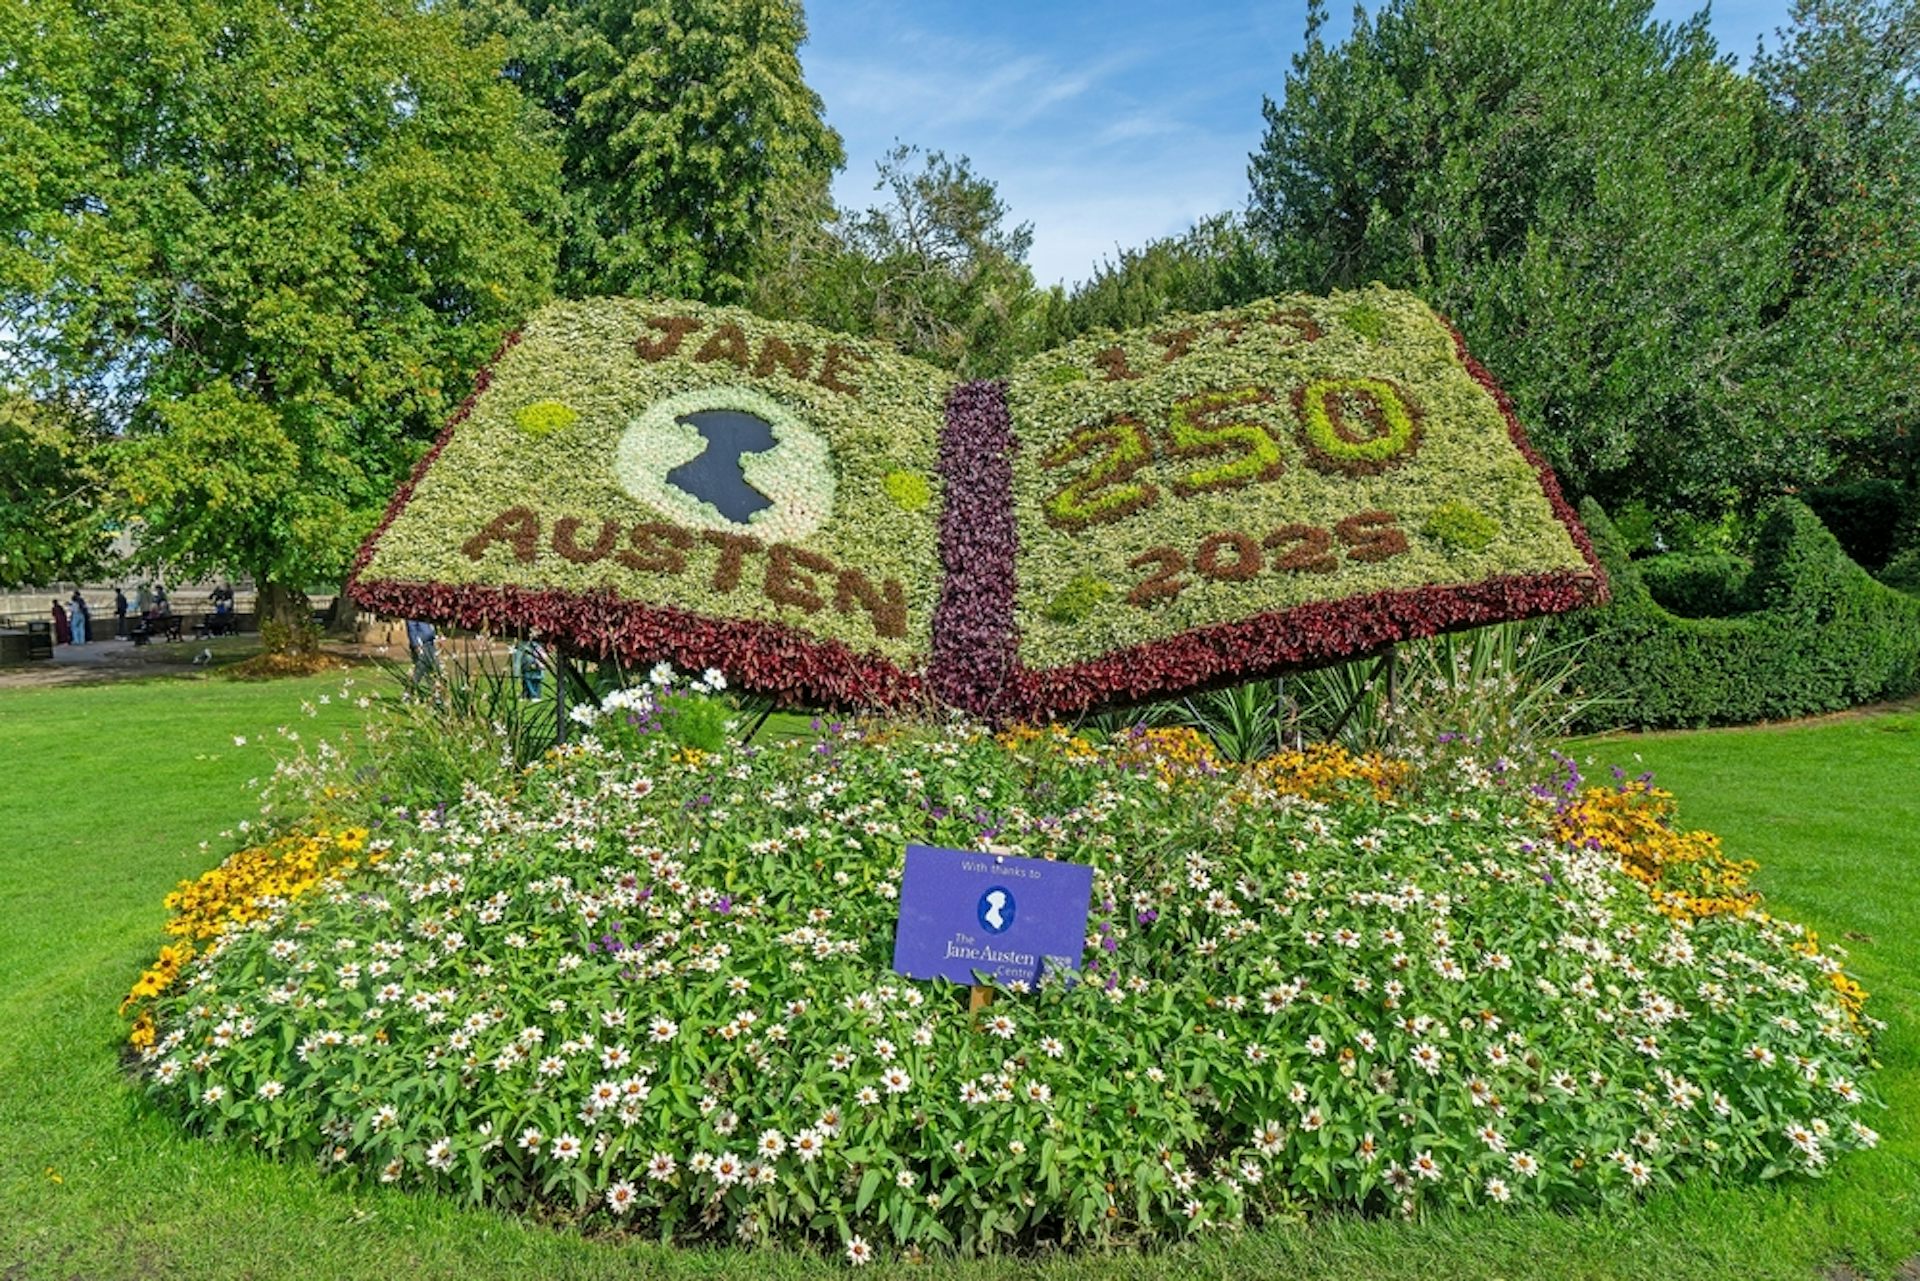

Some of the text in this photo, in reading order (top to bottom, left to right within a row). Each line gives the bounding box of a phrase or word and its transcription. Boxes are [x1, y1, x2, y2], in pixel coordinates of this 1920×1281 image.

[634, 315, 872, 397] JANE
[1041, 376, 1425, 535] 250
[461, 505, 907, 639] AUSTEN
[1126, 510, 1409, 606] 2025
[961, 861, 1042, 879] With thanks to
[944, 940, 1035, 966] Jane Austen
[955, 932, 975, 945] The
[996, 964, 1034, 979] Centre
